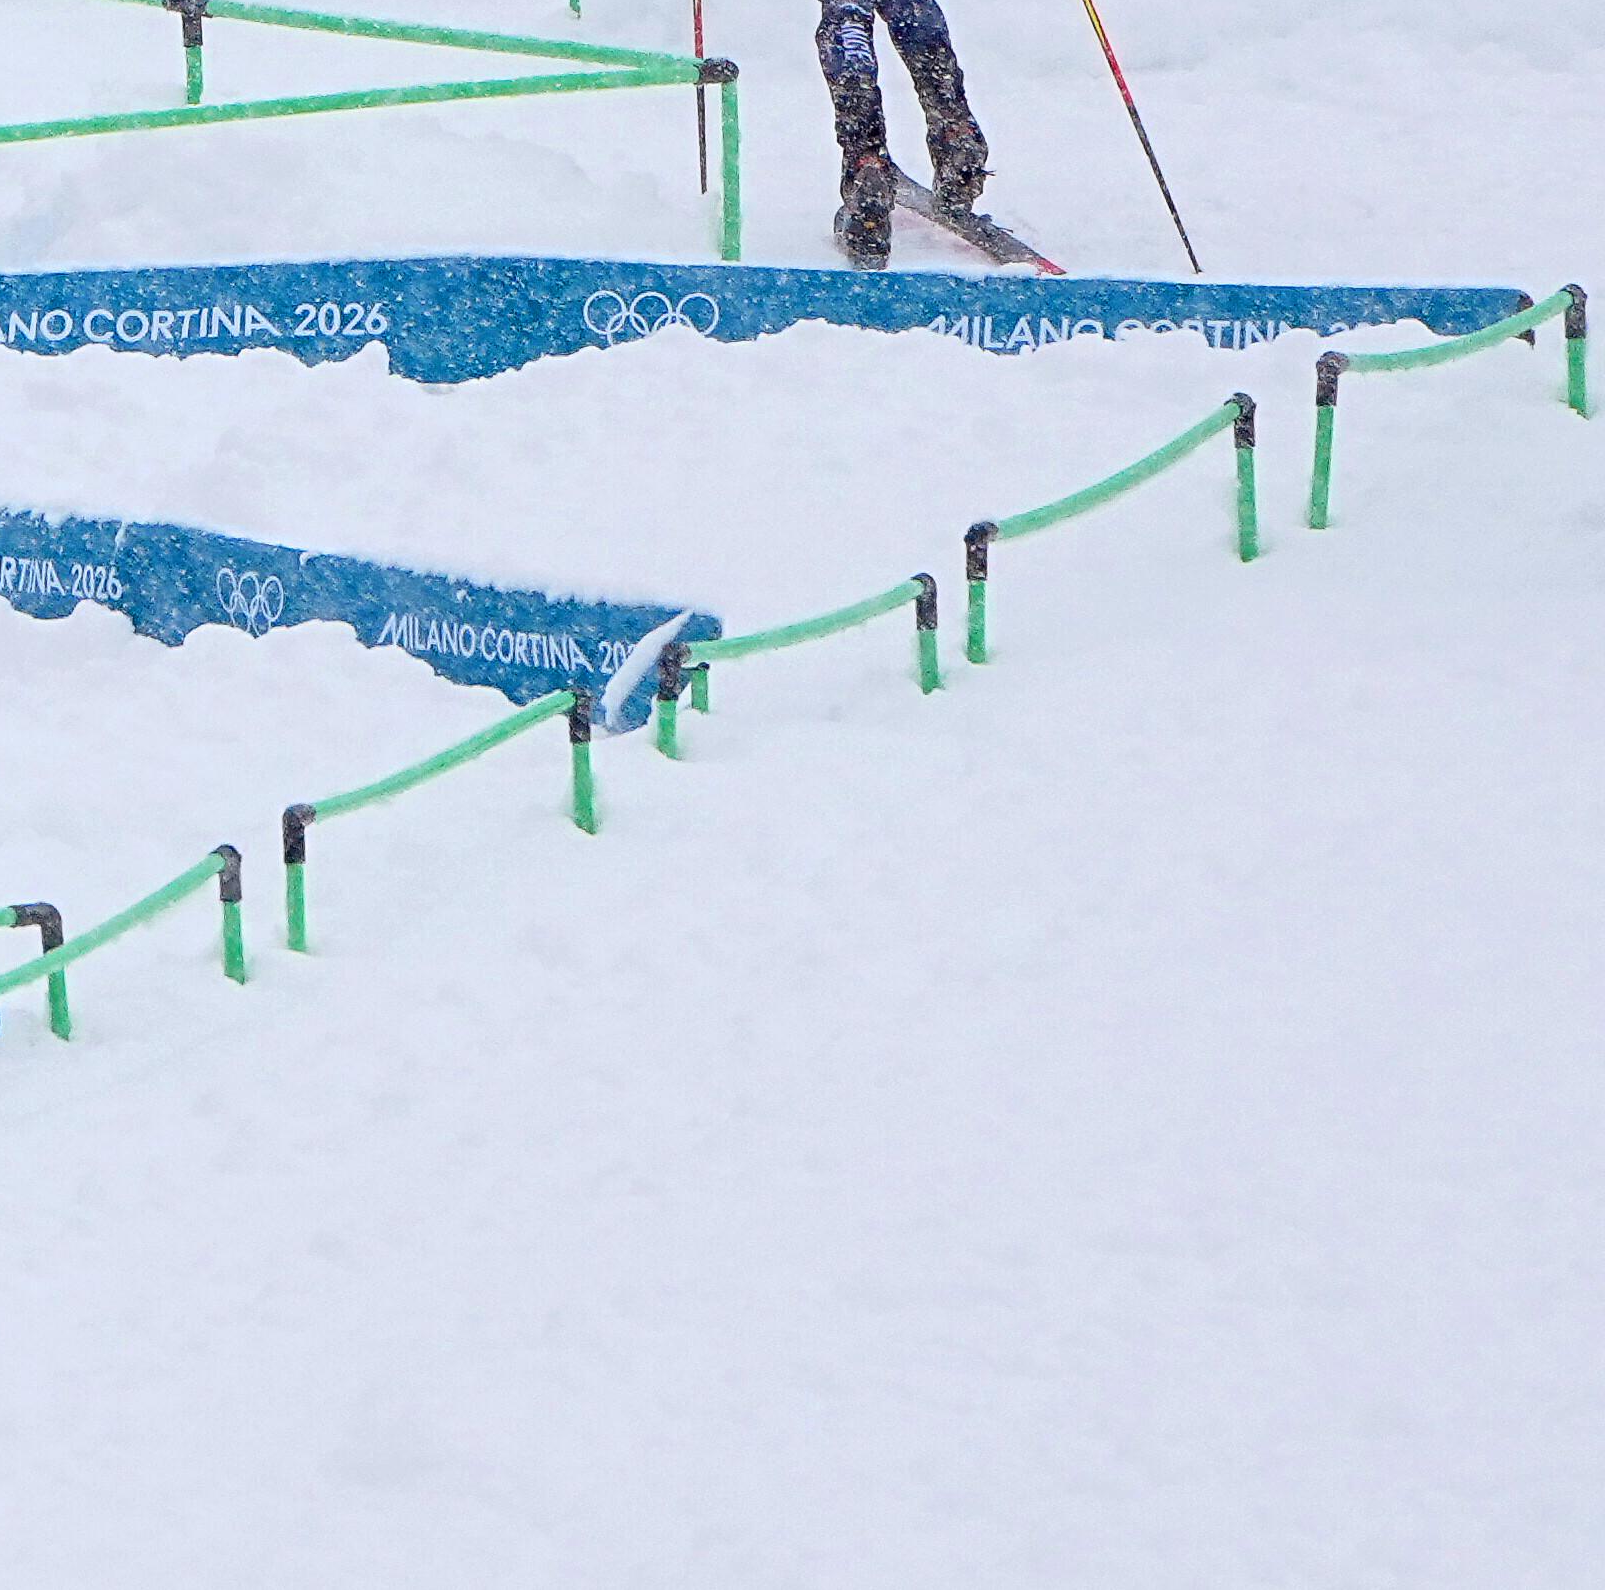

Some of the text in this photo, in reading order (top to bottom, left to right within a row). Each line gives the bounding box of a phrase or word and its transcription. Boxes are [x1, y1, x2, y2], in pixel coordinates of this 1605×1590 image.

[82, 305, 279, 343] CORTINA
[292, 301, 389, 338] 2026
[71, 564, 123, 600] 2026
[377, 612, 475, 657] MILANO
[480, 626, 594, 673] CORTINA
